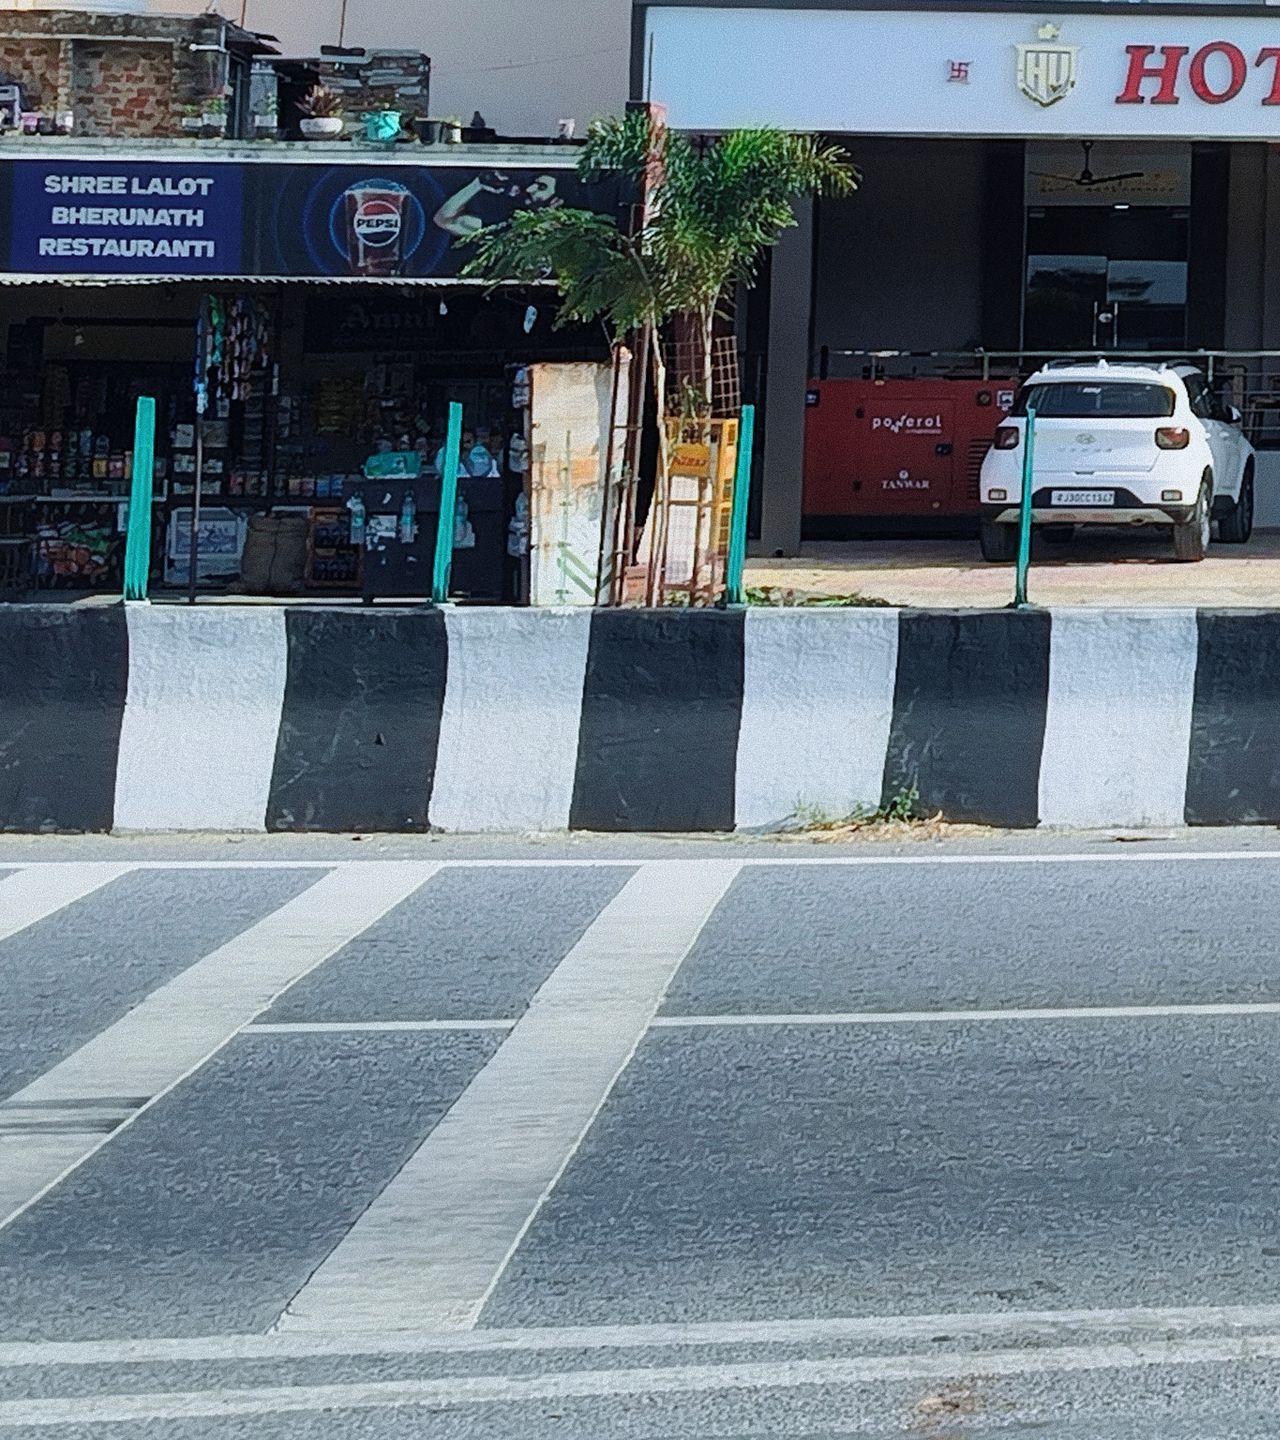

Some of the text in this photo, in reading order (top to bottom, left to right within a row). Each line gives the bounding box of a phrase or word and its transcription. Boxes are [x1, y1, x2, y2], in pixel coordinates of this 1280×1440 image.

[44, 175, 214, 196] SHREE LALOT
[51, 207, 204, 227] BHERUNATH
[355, 216, 400, 229] PEPSI
